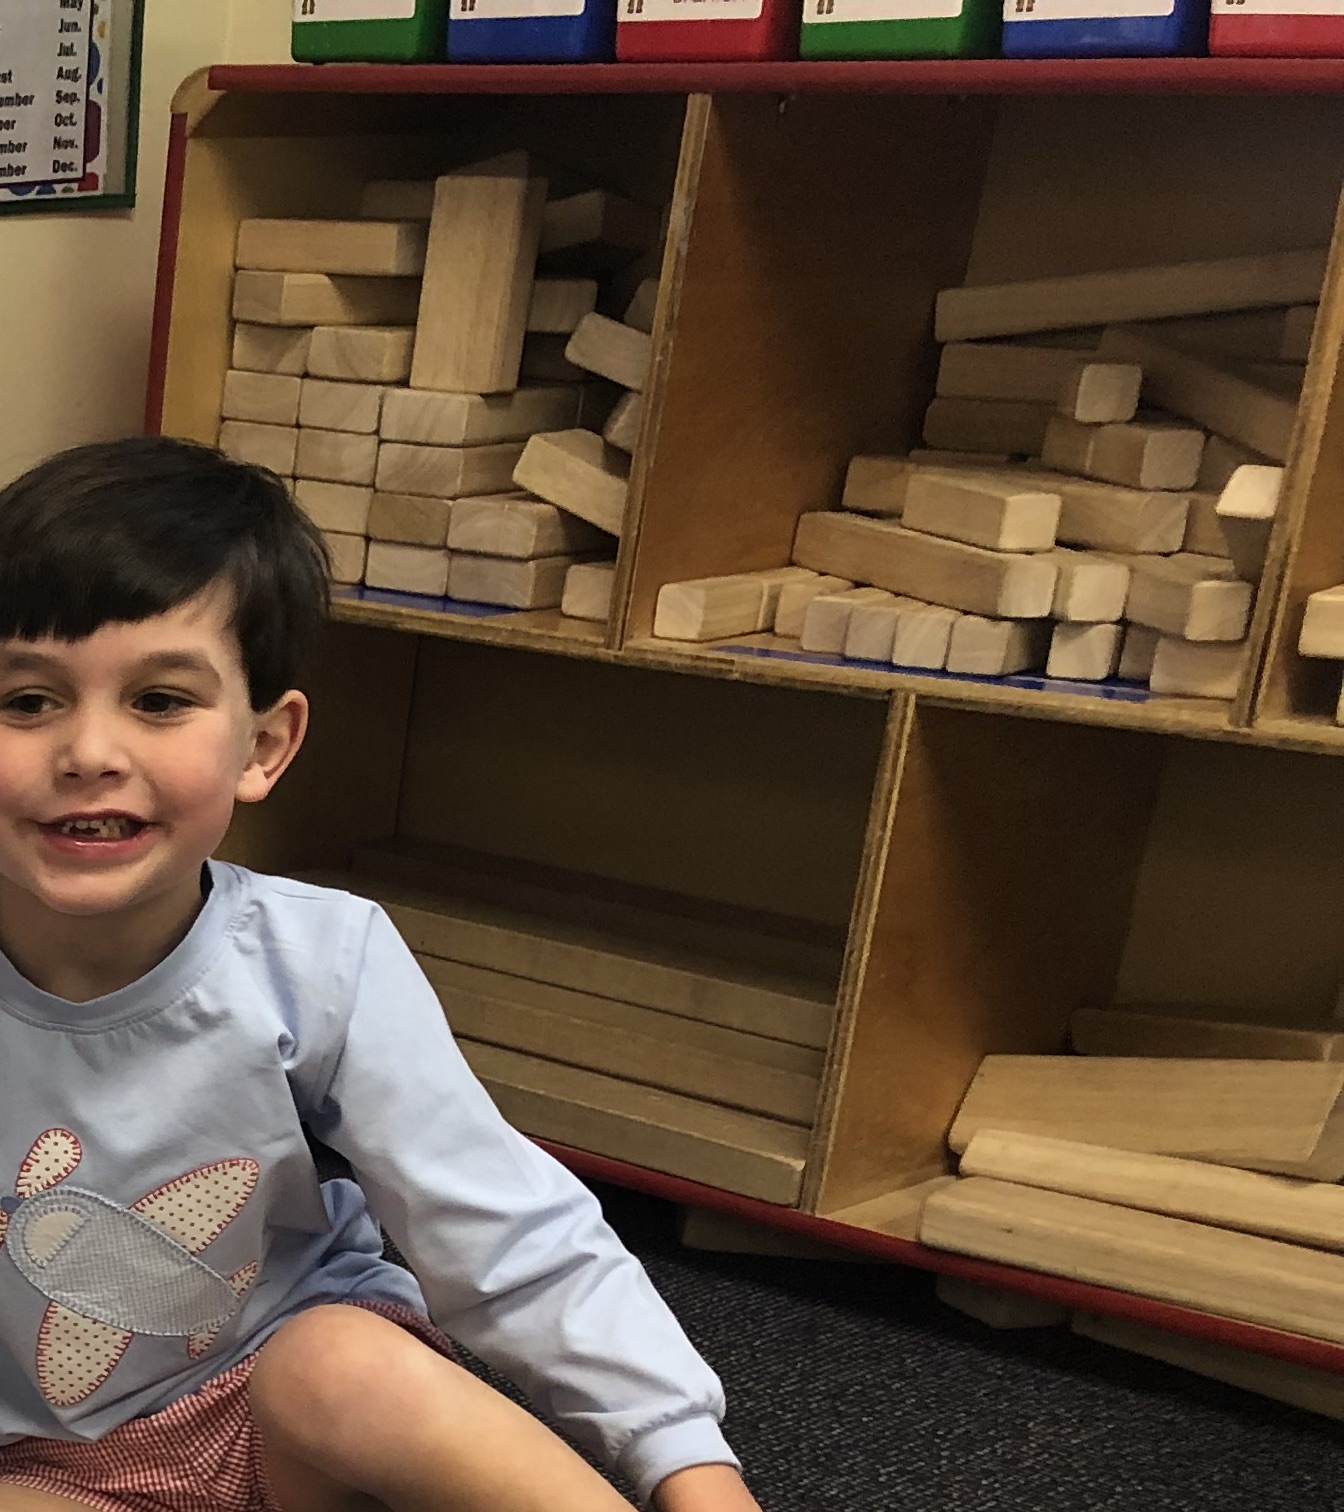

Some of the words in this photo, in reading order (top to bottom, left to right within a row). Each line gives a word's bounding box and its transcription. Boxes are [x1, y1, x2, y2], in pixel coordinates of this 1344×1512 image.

[59, 0, 83, 11] May
[57, 18, 82, 33] Jun.
[57, 42, 78, 57] Jul.
[55, 66, 82, 83] Aug.
[55, 89, 81, 105] Sep.
[54, 112, 78, 127] Oct.
[52, 136, 79, 150] Nov.
[52, 159, 78, 174] Dec.
